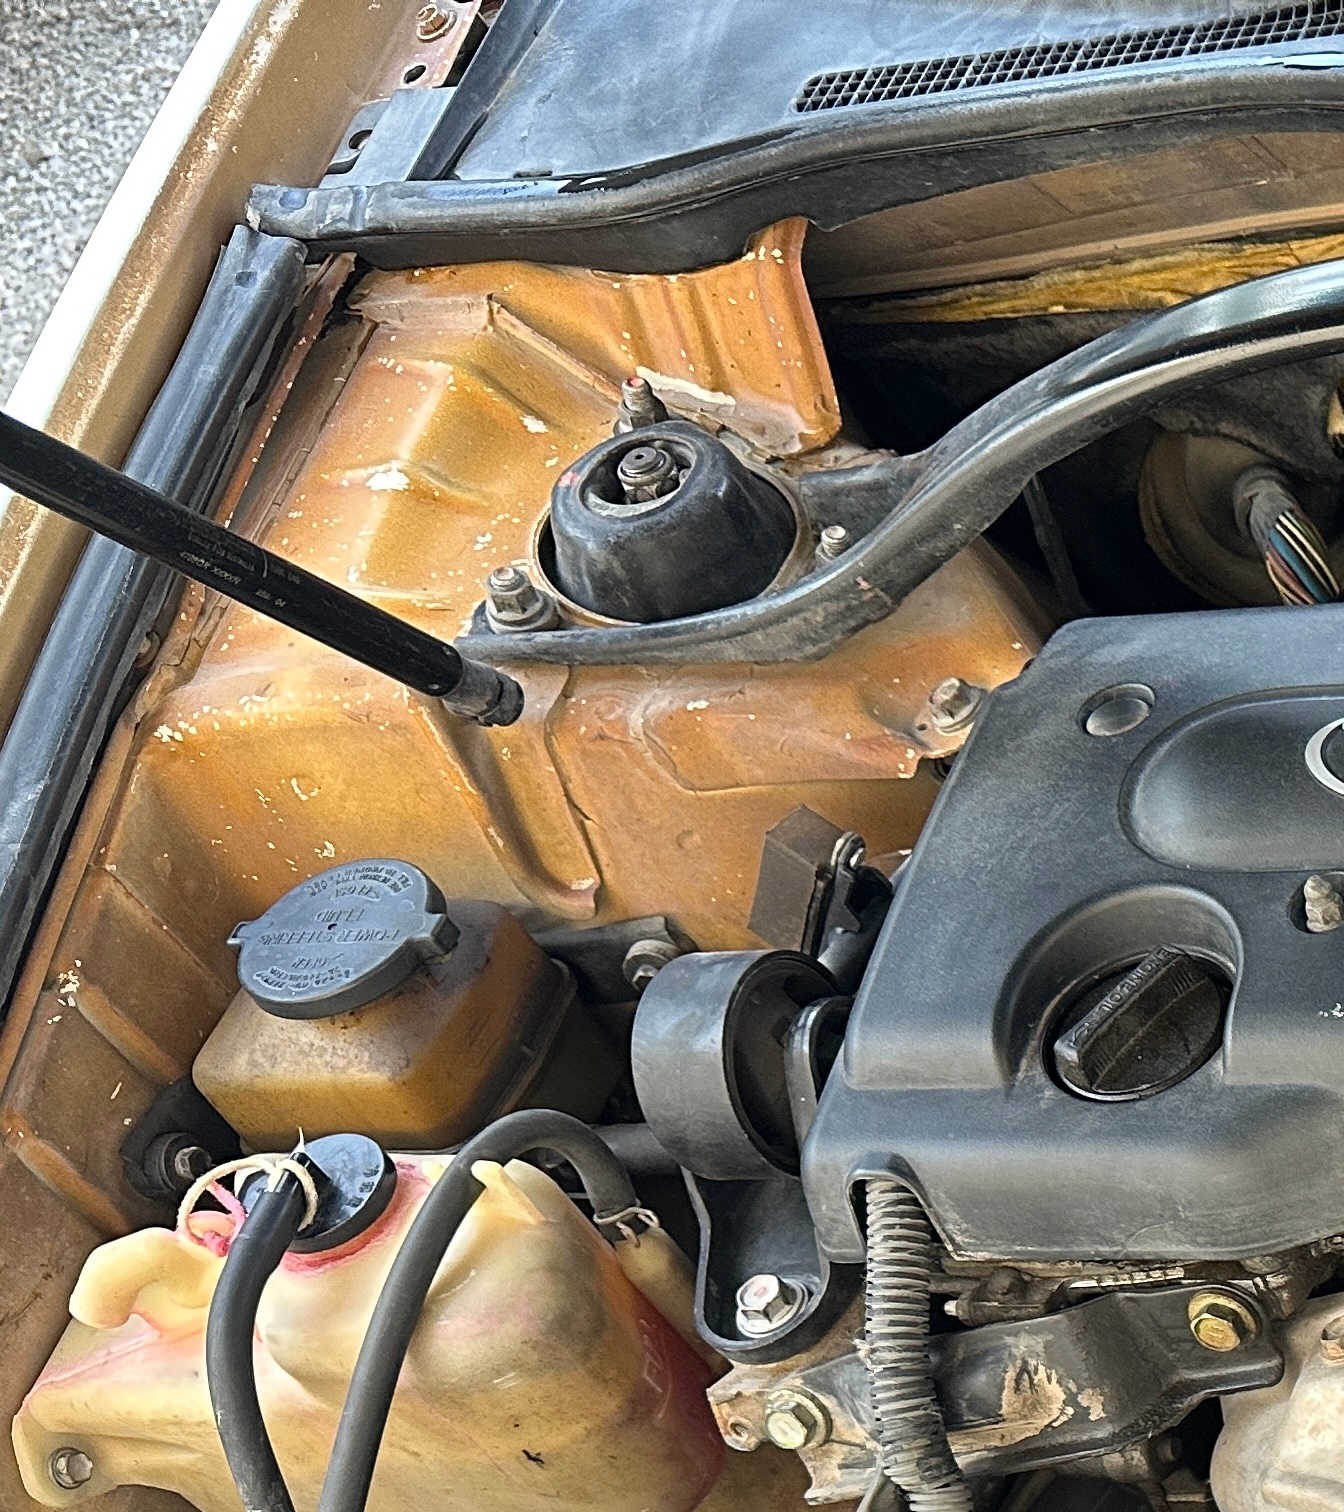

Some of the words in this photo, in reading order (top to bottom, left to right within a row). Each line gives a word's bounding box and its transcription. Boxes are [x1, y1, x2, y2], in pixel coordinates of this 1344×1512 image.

[315, 908, 365, 922] FLUID
[258, 930, 335, 946] STEERING
[336, 929, 400, 943] POWER
